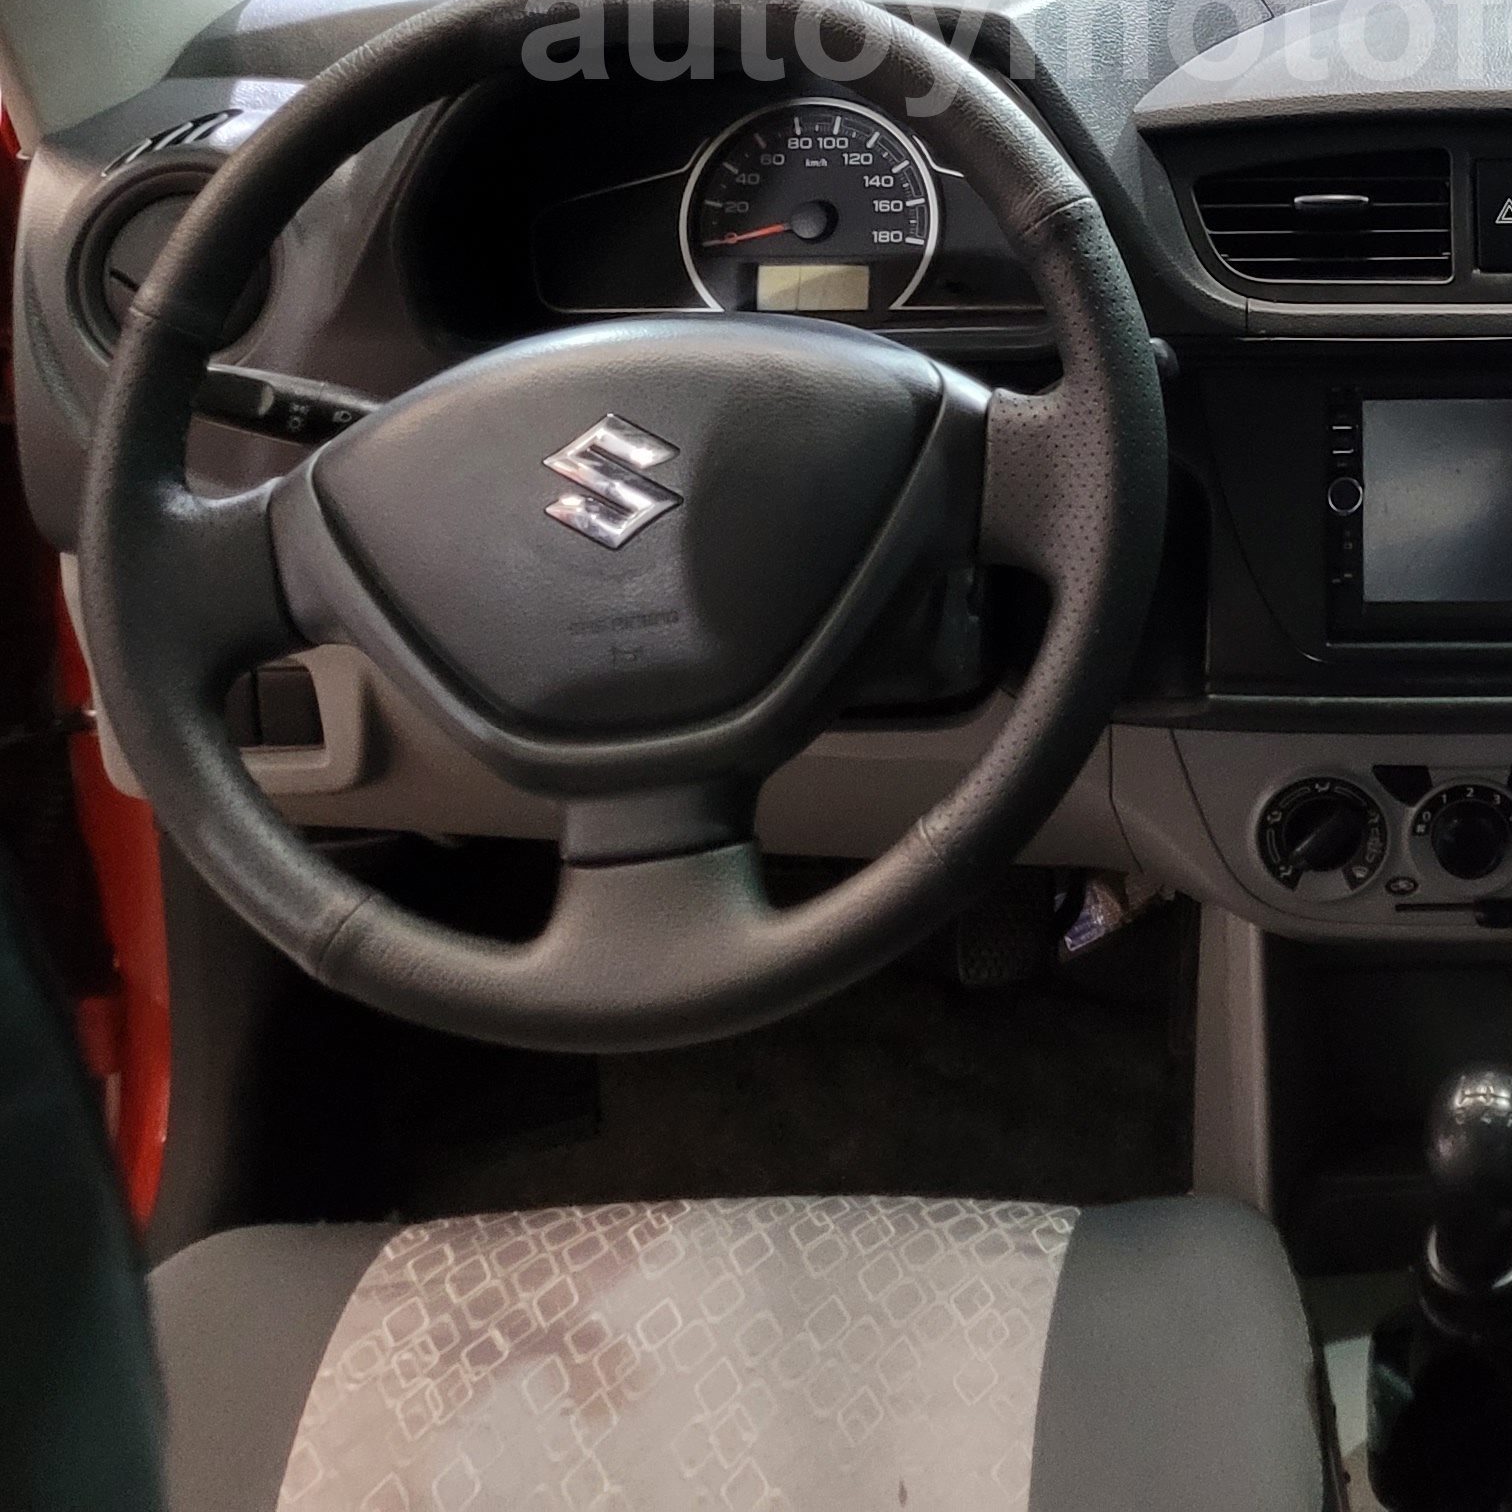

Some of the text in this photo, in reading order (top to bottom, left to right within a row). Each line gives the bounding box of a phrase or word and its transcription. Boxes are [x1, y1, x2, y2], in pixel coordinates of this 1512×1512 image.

[787, 137, 849, 149] 80 100
[760, 154, 785, 166] 60
[805, 157, 828, 167] km/h
[842, 153, 873, 165] 120
[735, 173, 760, 185] 40
[863, 176, 894, 188] 140
[724, 201, 749, 213] 20
[873, 200, 903, 212] 160
[872, 231, 903, 243] 180
[1422, 810, 1432, 822] 0
[1440, 793, 1448, 804] 1
[1466, 787, 1475, 798] 2
[1493, 793, 1501, 805] 3
